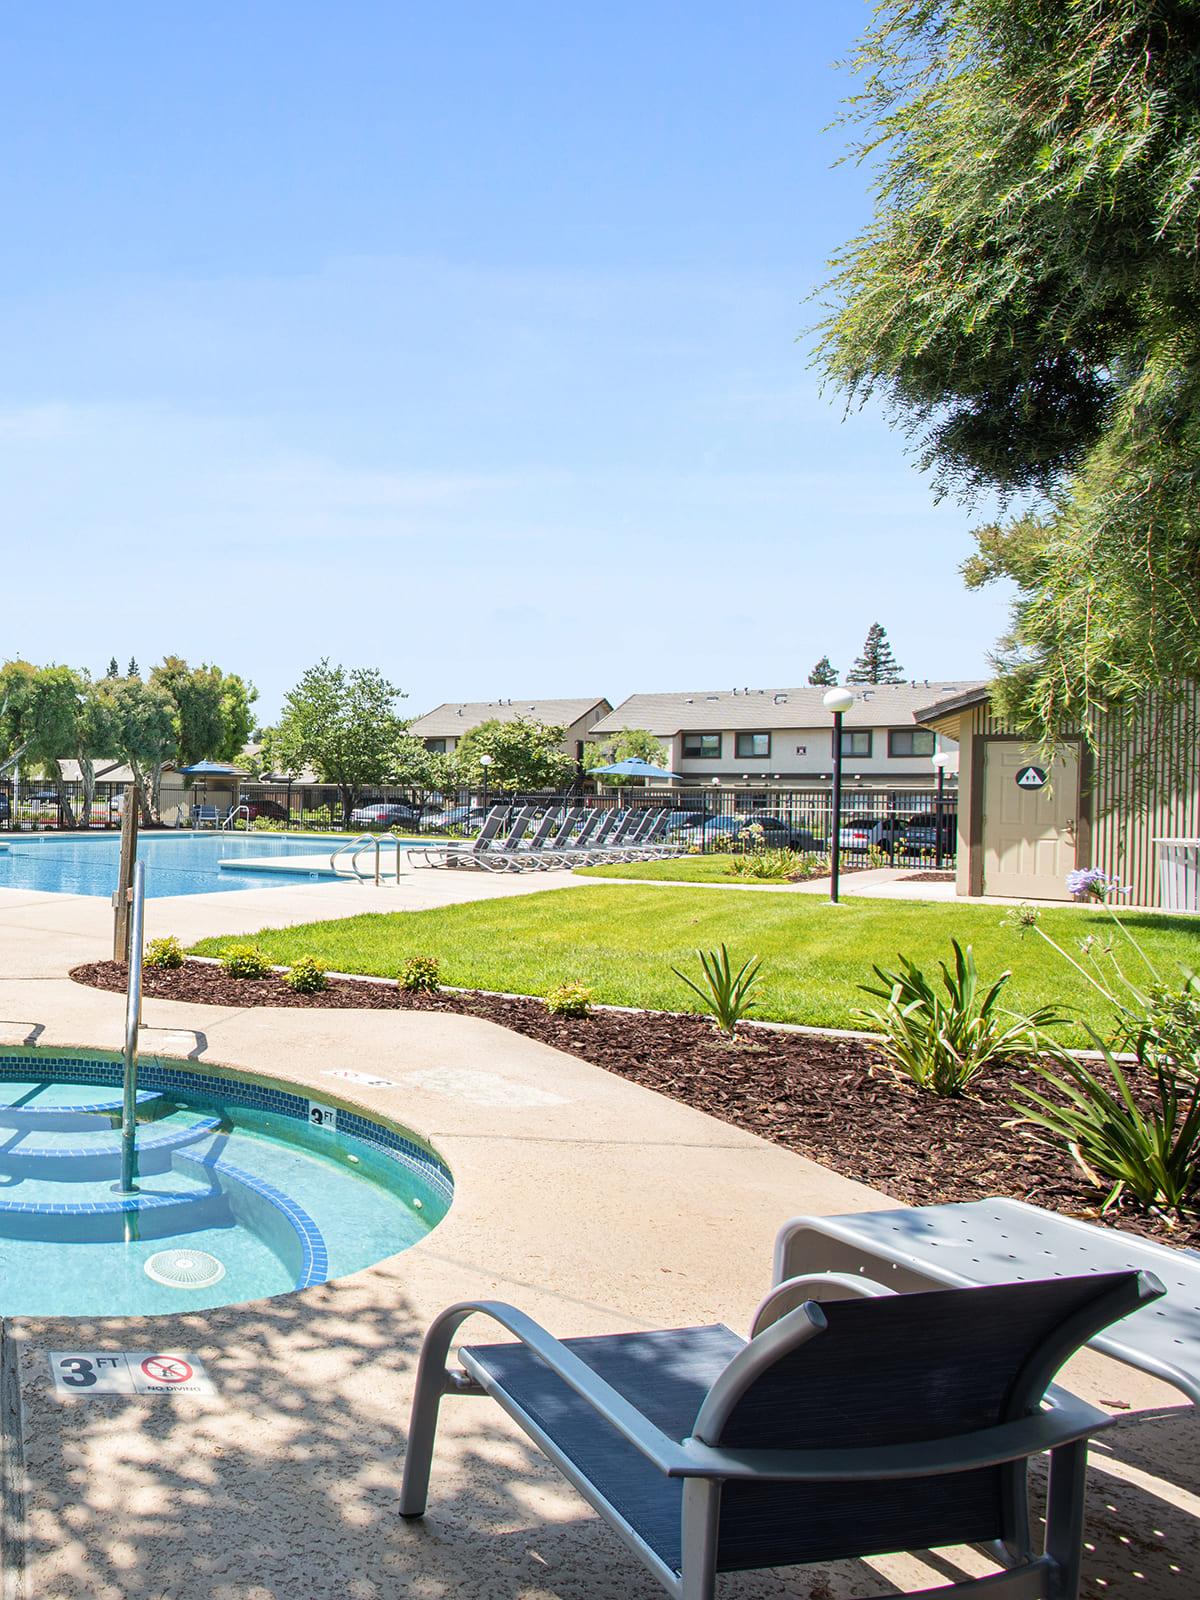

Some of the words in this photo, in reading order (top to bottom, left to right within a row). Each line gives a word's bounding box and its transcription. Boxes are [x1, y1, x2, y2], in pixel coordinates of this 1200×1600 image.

[324, 1111, 333, 1122] FT
[60, 1357, 98, 1387] 3
[95, 1357, 119, 1368] FT
